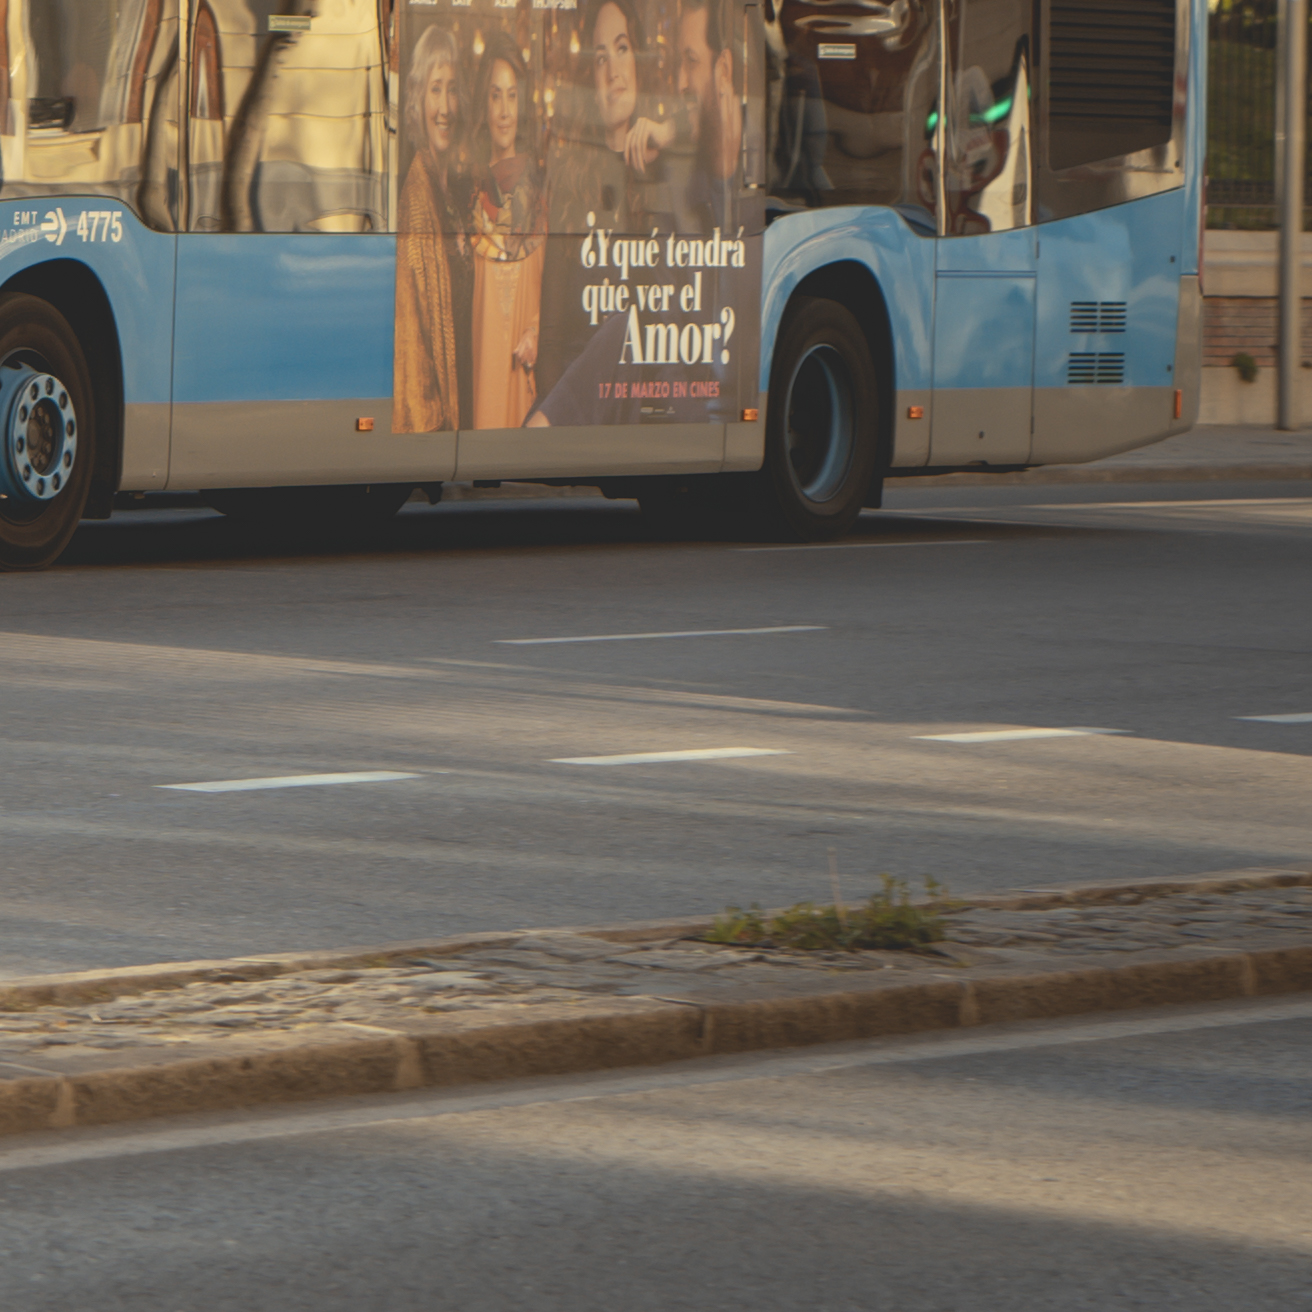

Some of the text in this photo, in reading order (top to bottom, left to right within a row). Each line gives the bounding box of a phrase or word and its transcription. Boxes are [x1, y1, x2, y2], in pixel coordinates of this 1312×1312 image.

[13, 211, 38, 225] EMT
[77, 211, 122, 242] 4775
[613, 227, 660, 280] qué
[666, 226, 745, 267] tendrá
[582, 271, 702, 325] que ver el
[618, 304, 735, 364] Amor?
[599, 381, 720, 398] 17 DE MARZO EN CINES
